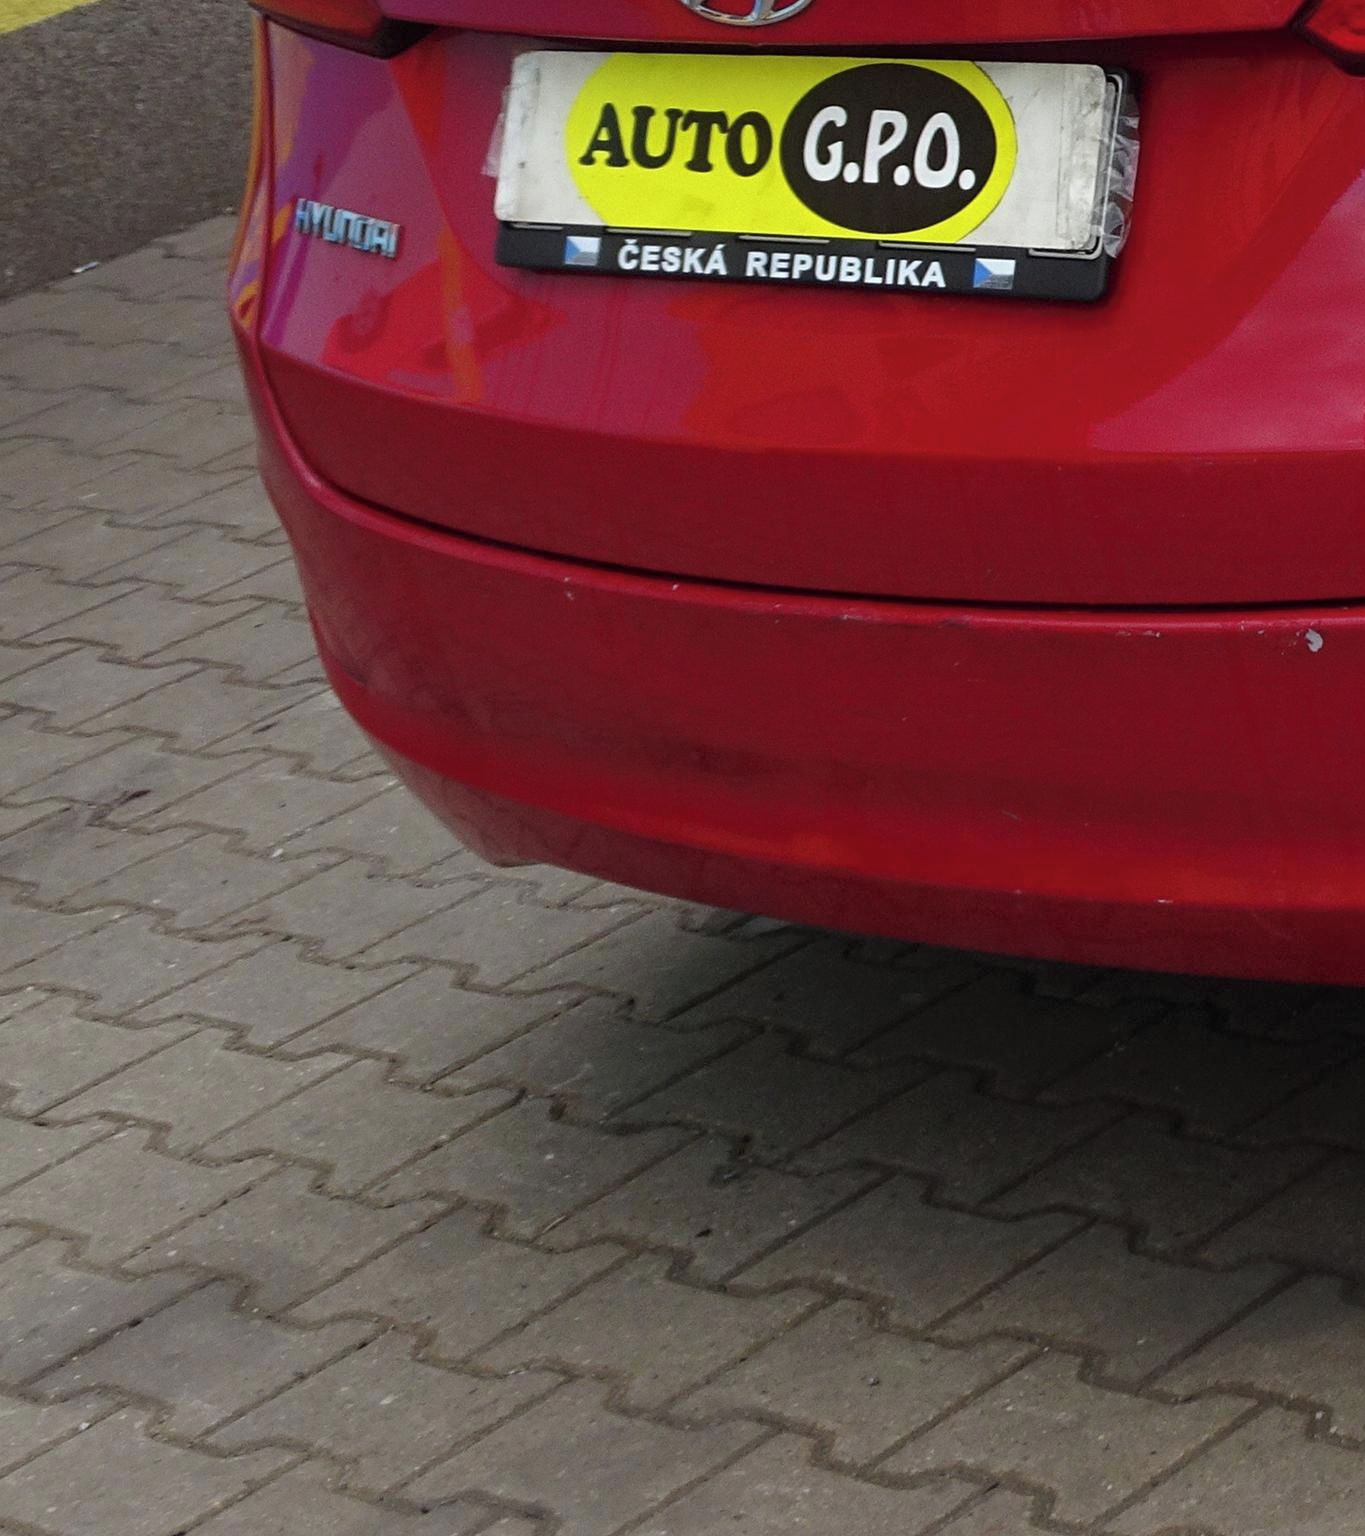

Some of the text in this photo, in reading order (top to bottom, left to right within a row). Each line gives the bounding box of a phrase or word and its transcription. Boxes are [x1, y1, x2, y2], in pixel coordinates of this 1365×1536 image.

[579, 102, 976, 190] AUTO G.P.O.
[617, 239, 946, 288] ČESKÁ REPUBLIKA
